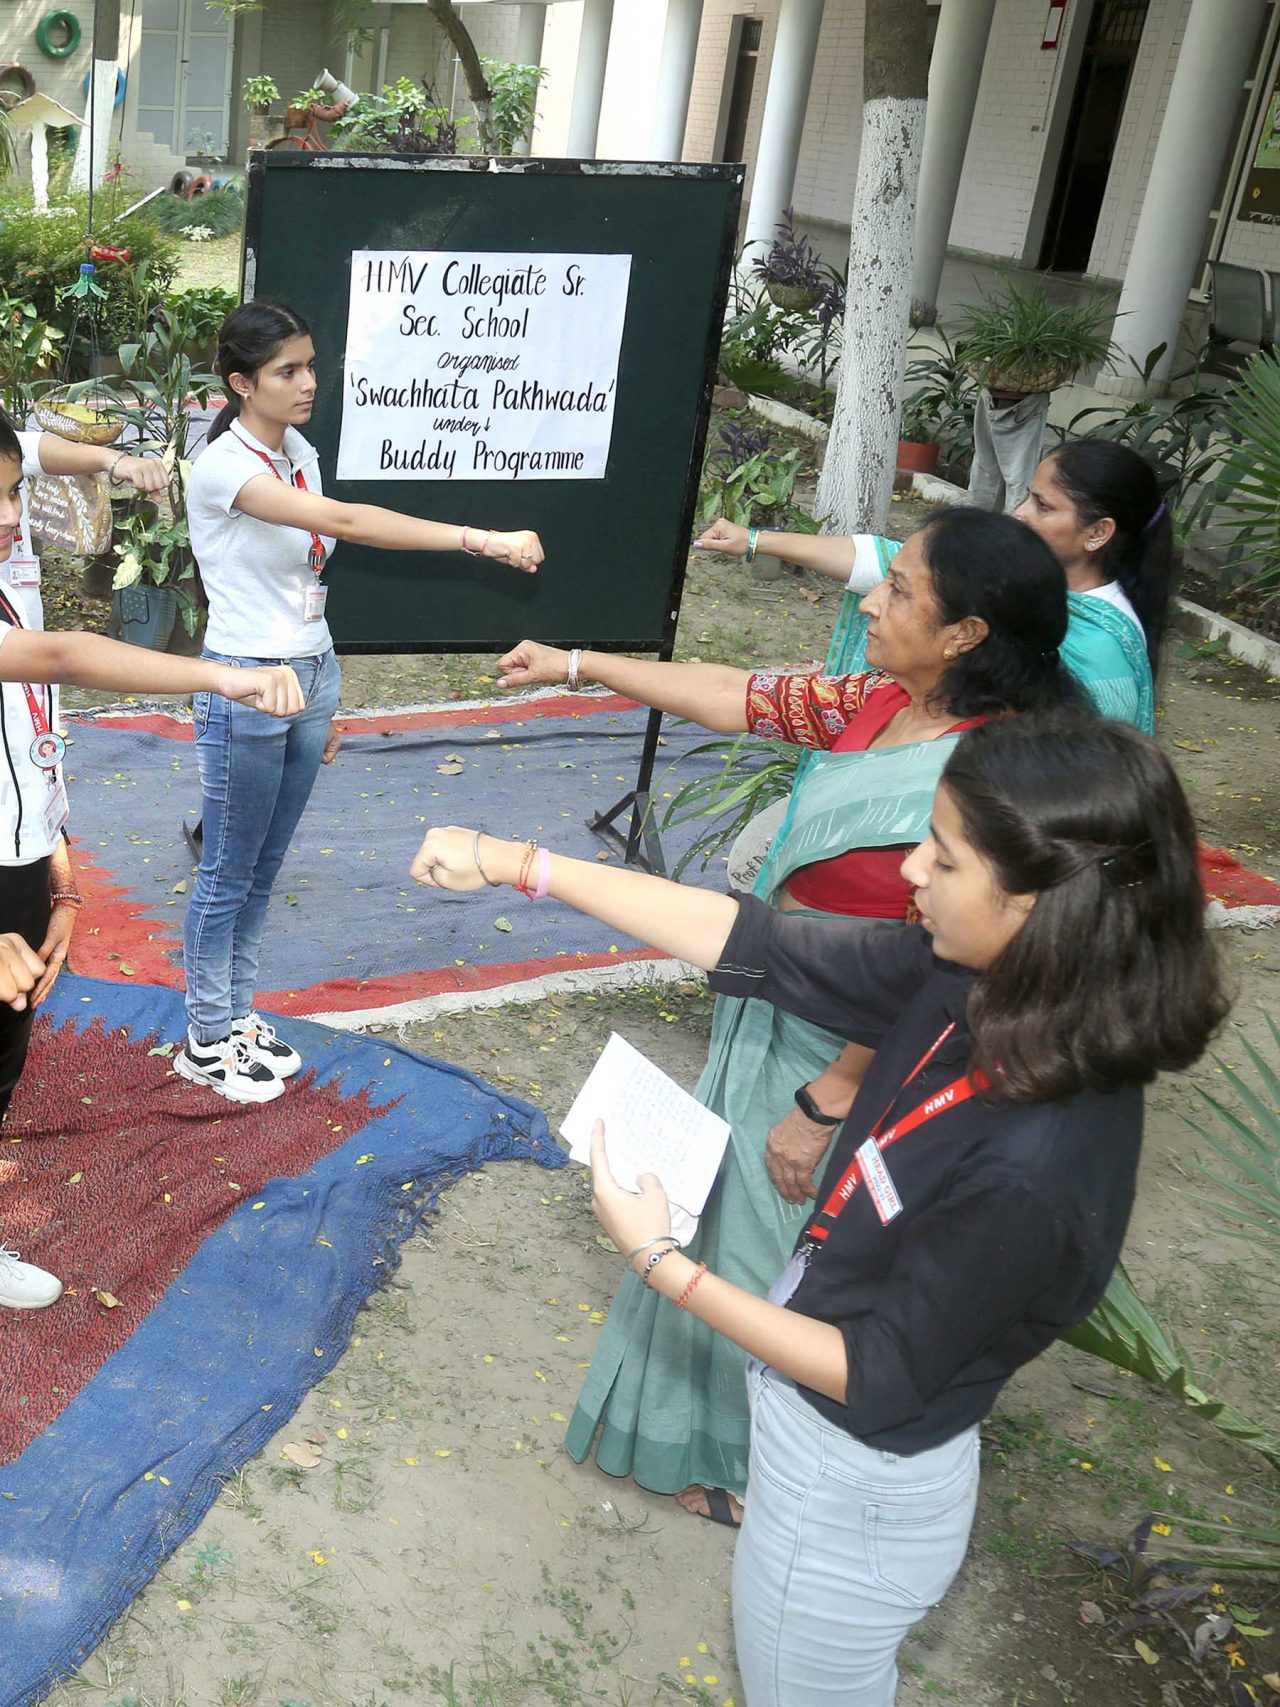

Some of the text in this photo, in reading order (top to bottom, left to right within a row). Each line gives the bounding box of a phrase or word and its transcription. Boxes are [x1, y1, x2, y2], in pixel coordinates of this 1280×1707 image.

[441, 260, 547, 306] Collegiate
[562, 264, 587, 297] Sr.
[400, 304, 530, 339] Sec. School
[433, 416, 482, 436] under
[380, 439, 585, 480] Buddy Programme
[32, 712, 43, 732] HMV
[924, 1089, 955, 1115] HMV
[879, 1129, 897, 1146] MV
[838, 1173, 859, 1201] HMV
